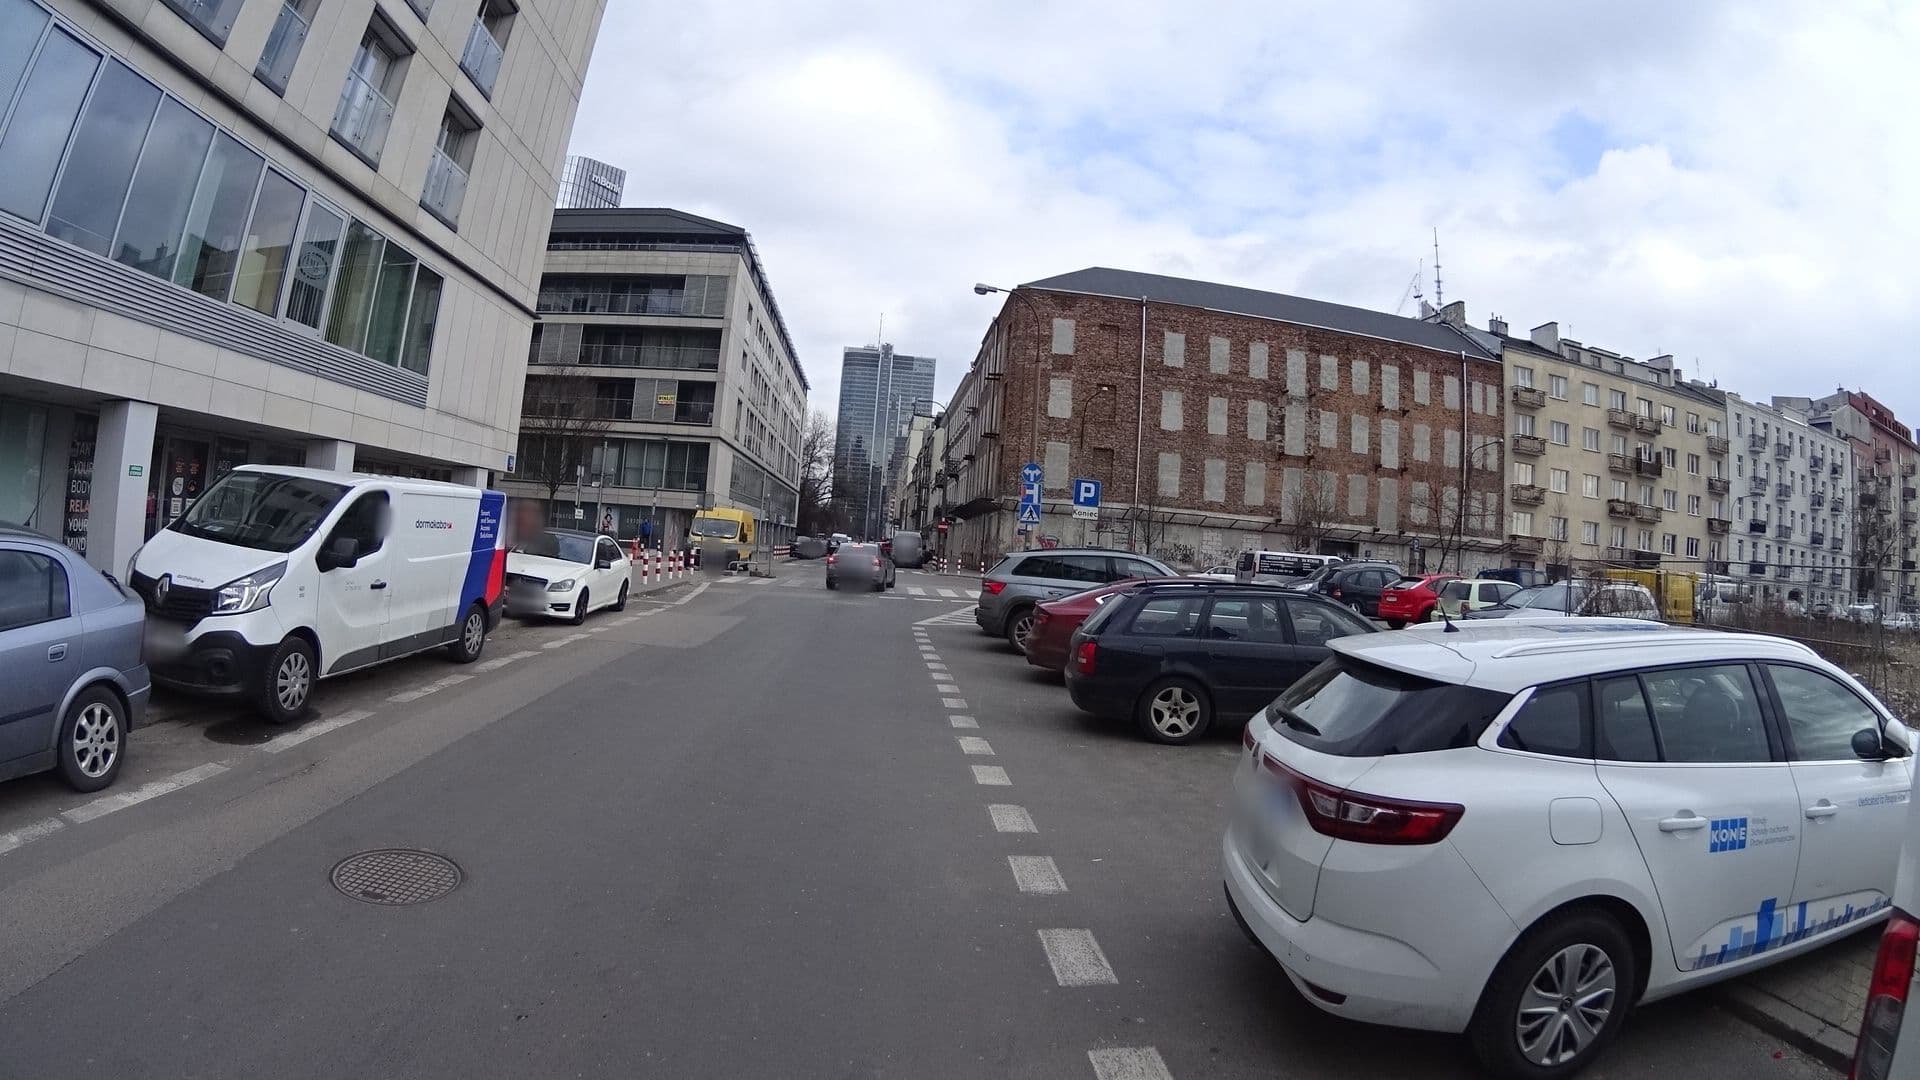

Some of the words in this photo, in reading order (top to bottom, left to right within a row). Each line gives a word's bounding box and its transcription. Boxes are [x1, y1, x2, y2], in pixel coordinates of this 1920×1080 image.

[592, 174, 621, 193] mBank
[71, 479, 91, 493] BODY
[1079, 482, 1096, 503] P
[69, 499, 90, 513] RELA
[1073, 509, 1098, 518] Koniec
[68, 518, 89, 532] YOUR
[415, 520, 447, 529] dormakaba
[67, 537, 87, 551] MIND
[1711, 827, 1746, 844] KONE
